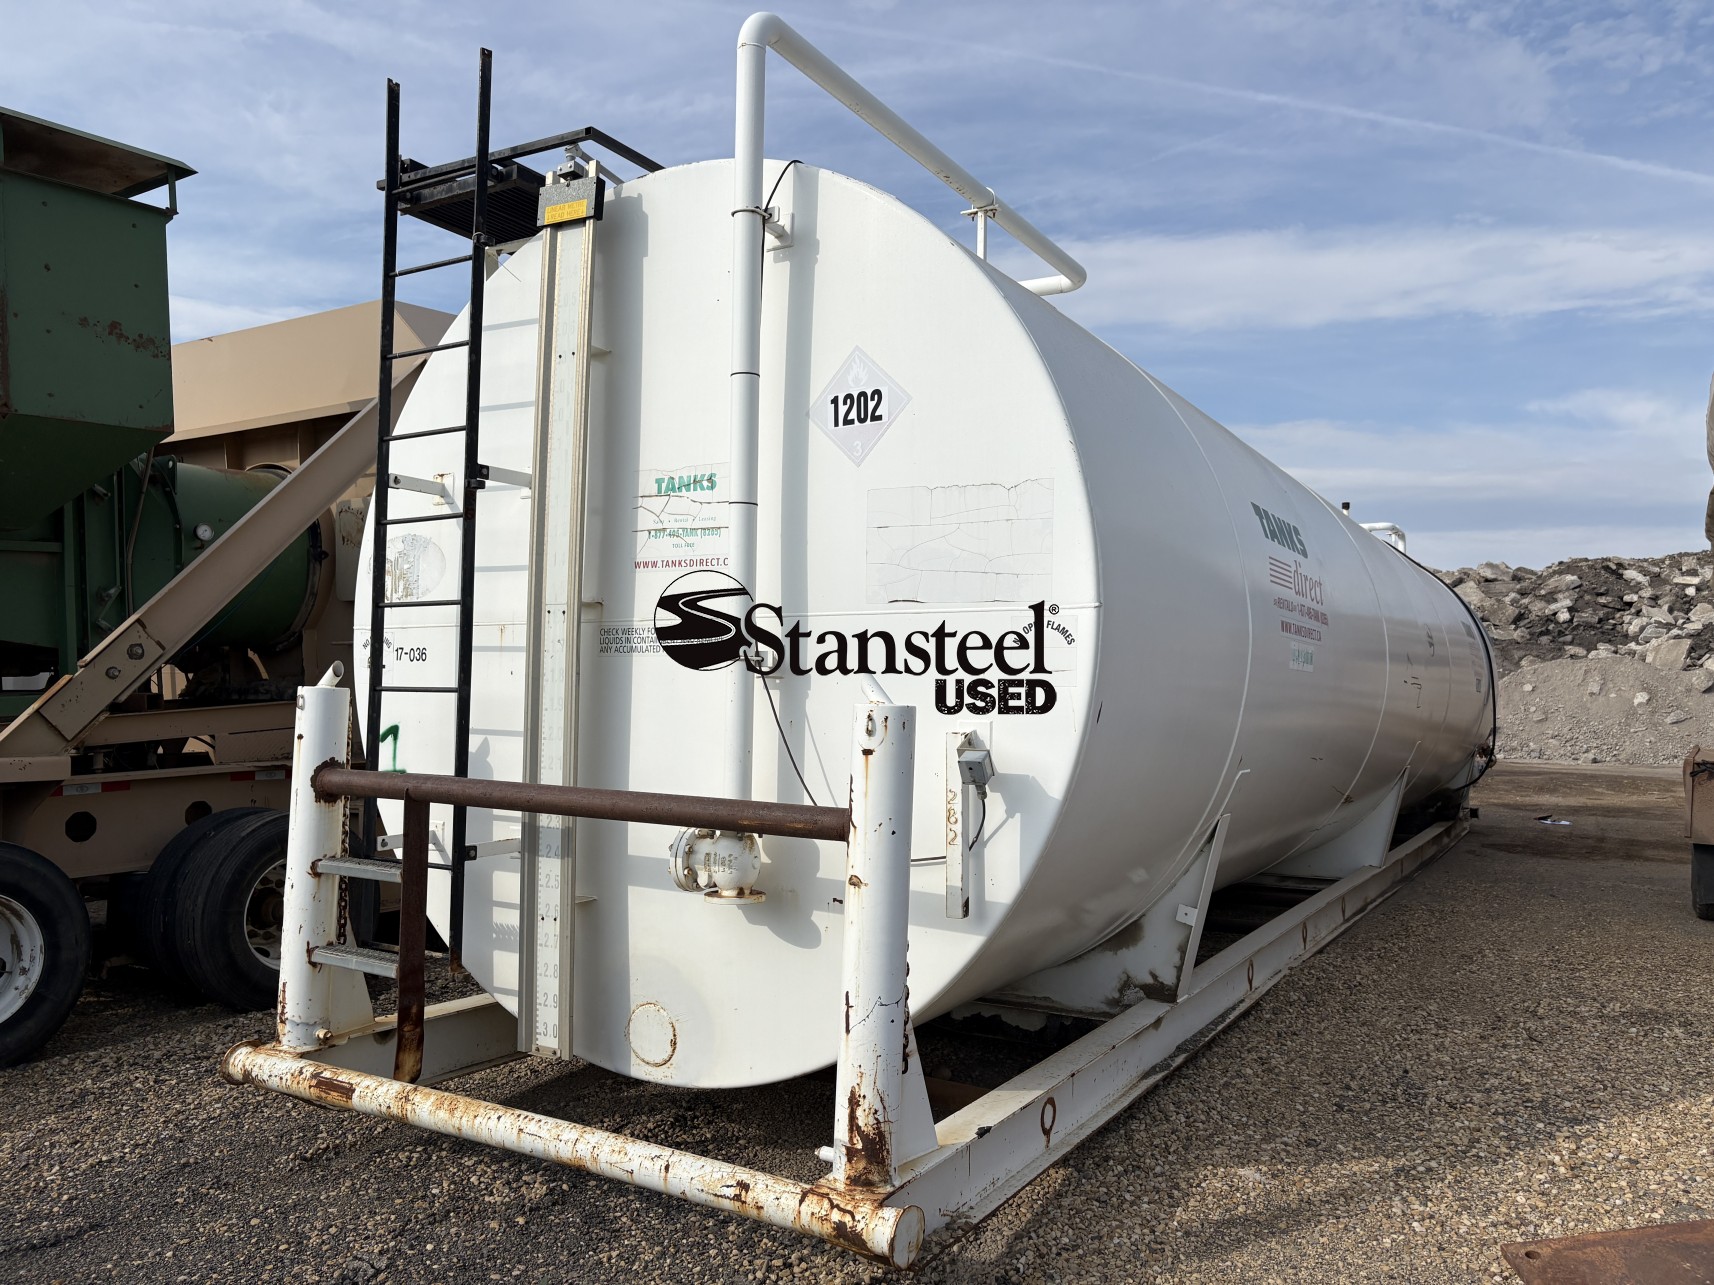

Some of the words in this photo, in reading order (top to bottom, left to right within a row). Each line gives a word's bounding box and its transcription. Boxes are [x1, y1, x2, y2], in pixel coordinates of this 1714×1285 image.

[830, 388, 883, 428] 1202
[852, 440, 862, 457] 3
[655, 472, 718, 495] TANKS
[1250, 501, 1308, 559] TANKS
[634, 557, 729, 570] WWW.TANKSDIRECT.C
[1293, 560, 1324, 606] direct
[600, 627, 620, 636] CHECK
[621, 627, 646, 636] WEEKLY
[647, 627, 657, 636] FO
[1046, 619, 1076, 646] FLAMES
[600, 636, 624, 646] LIQUIDS
[625, 636, 632, 645] IN
[600, 645, 613, 654] ANY
[614, 645, 661, 654] ACCUMULATED
[394, 646, 427, 662] 17-036
